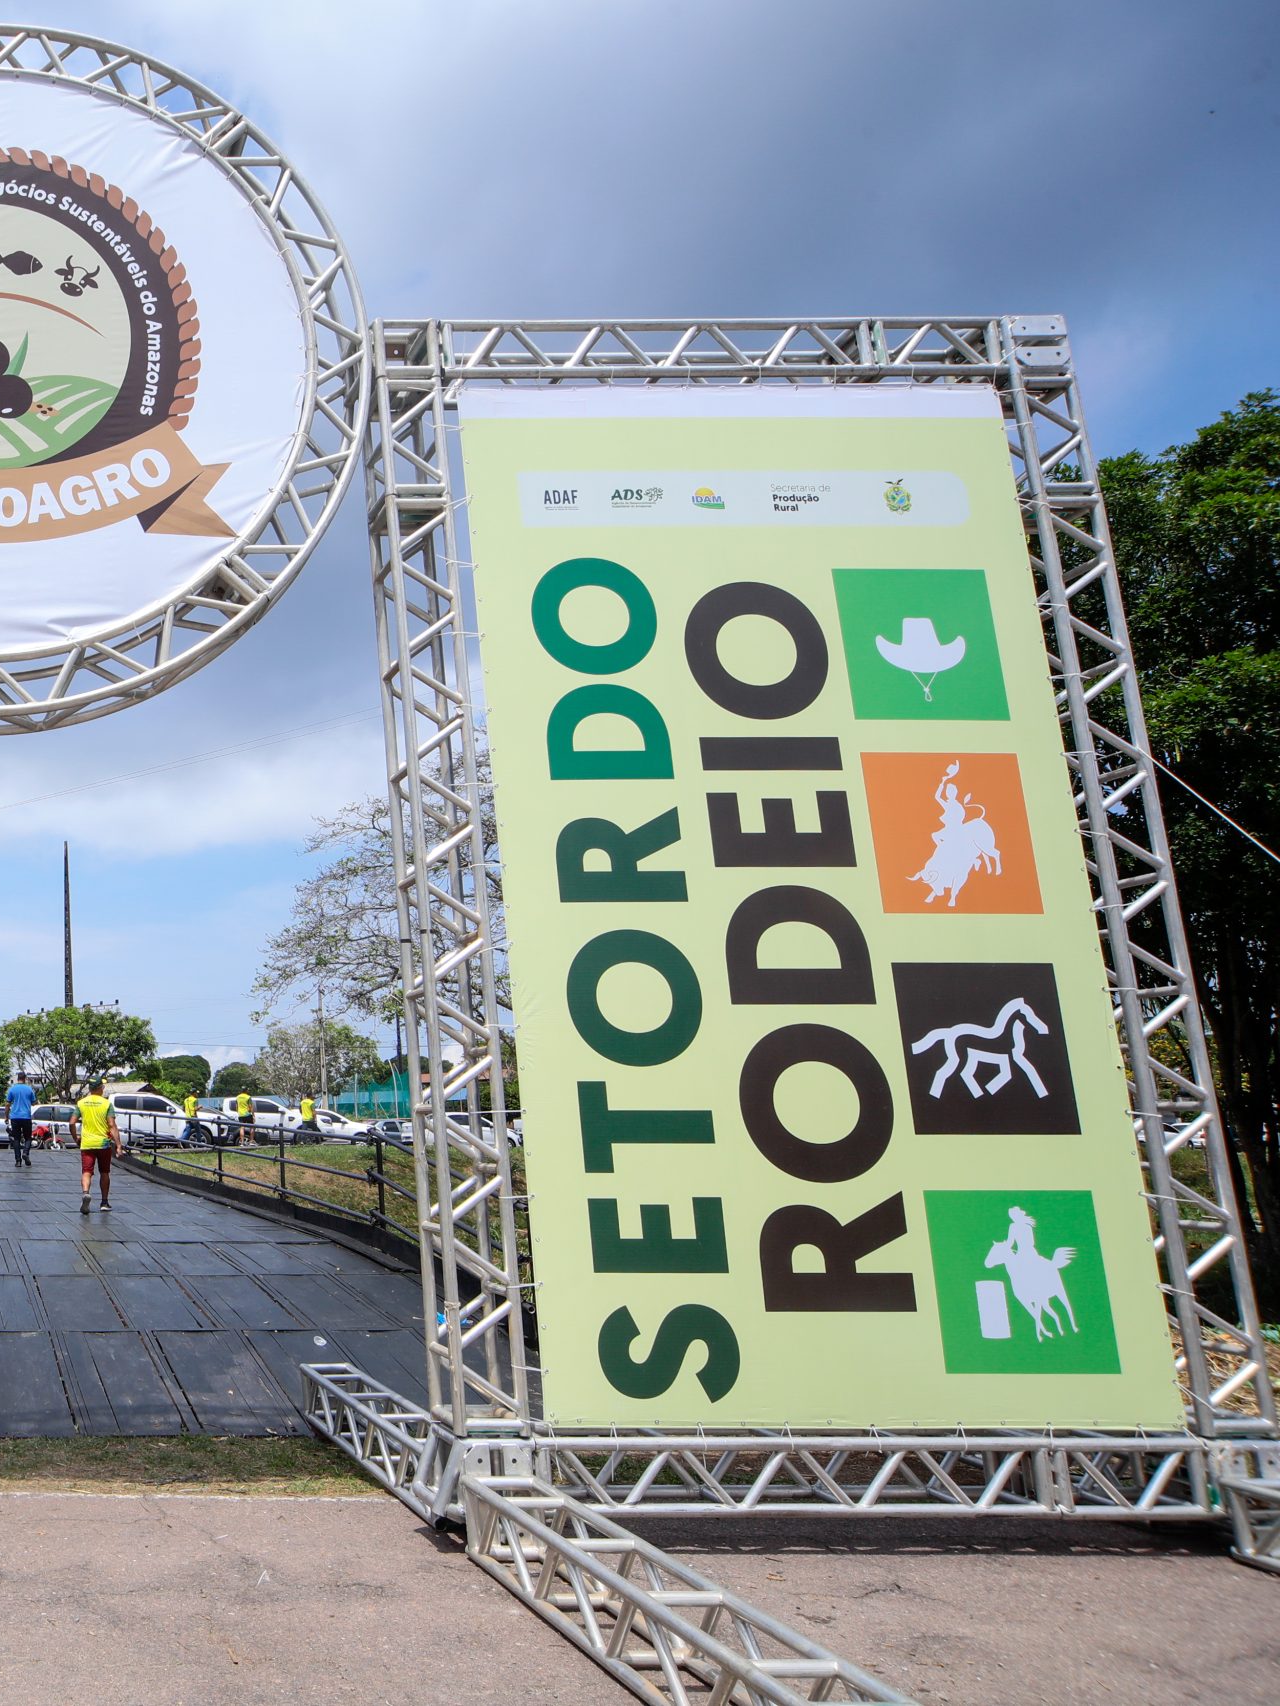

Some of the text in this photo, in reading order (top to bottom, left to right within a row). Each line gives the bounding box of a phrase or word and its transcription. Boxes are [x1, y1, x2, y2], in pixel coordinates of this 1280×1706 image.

[58, 196, 148, 288] Sustentáveis
[139, 290, 158, 316] do
[140, 319, 163, 416] Amazonas
[611, 488, 644, 501] ADS
[770, 483, 831, 492] Secretaria de
[544, 489, 578, 505] ADAF
[691, 495, 722, 503] IDAM
[772, 494, 820, 504] Produção
[773, 503, 799, 512] Rural
[685, 582, 917, 1312] RODEIO
